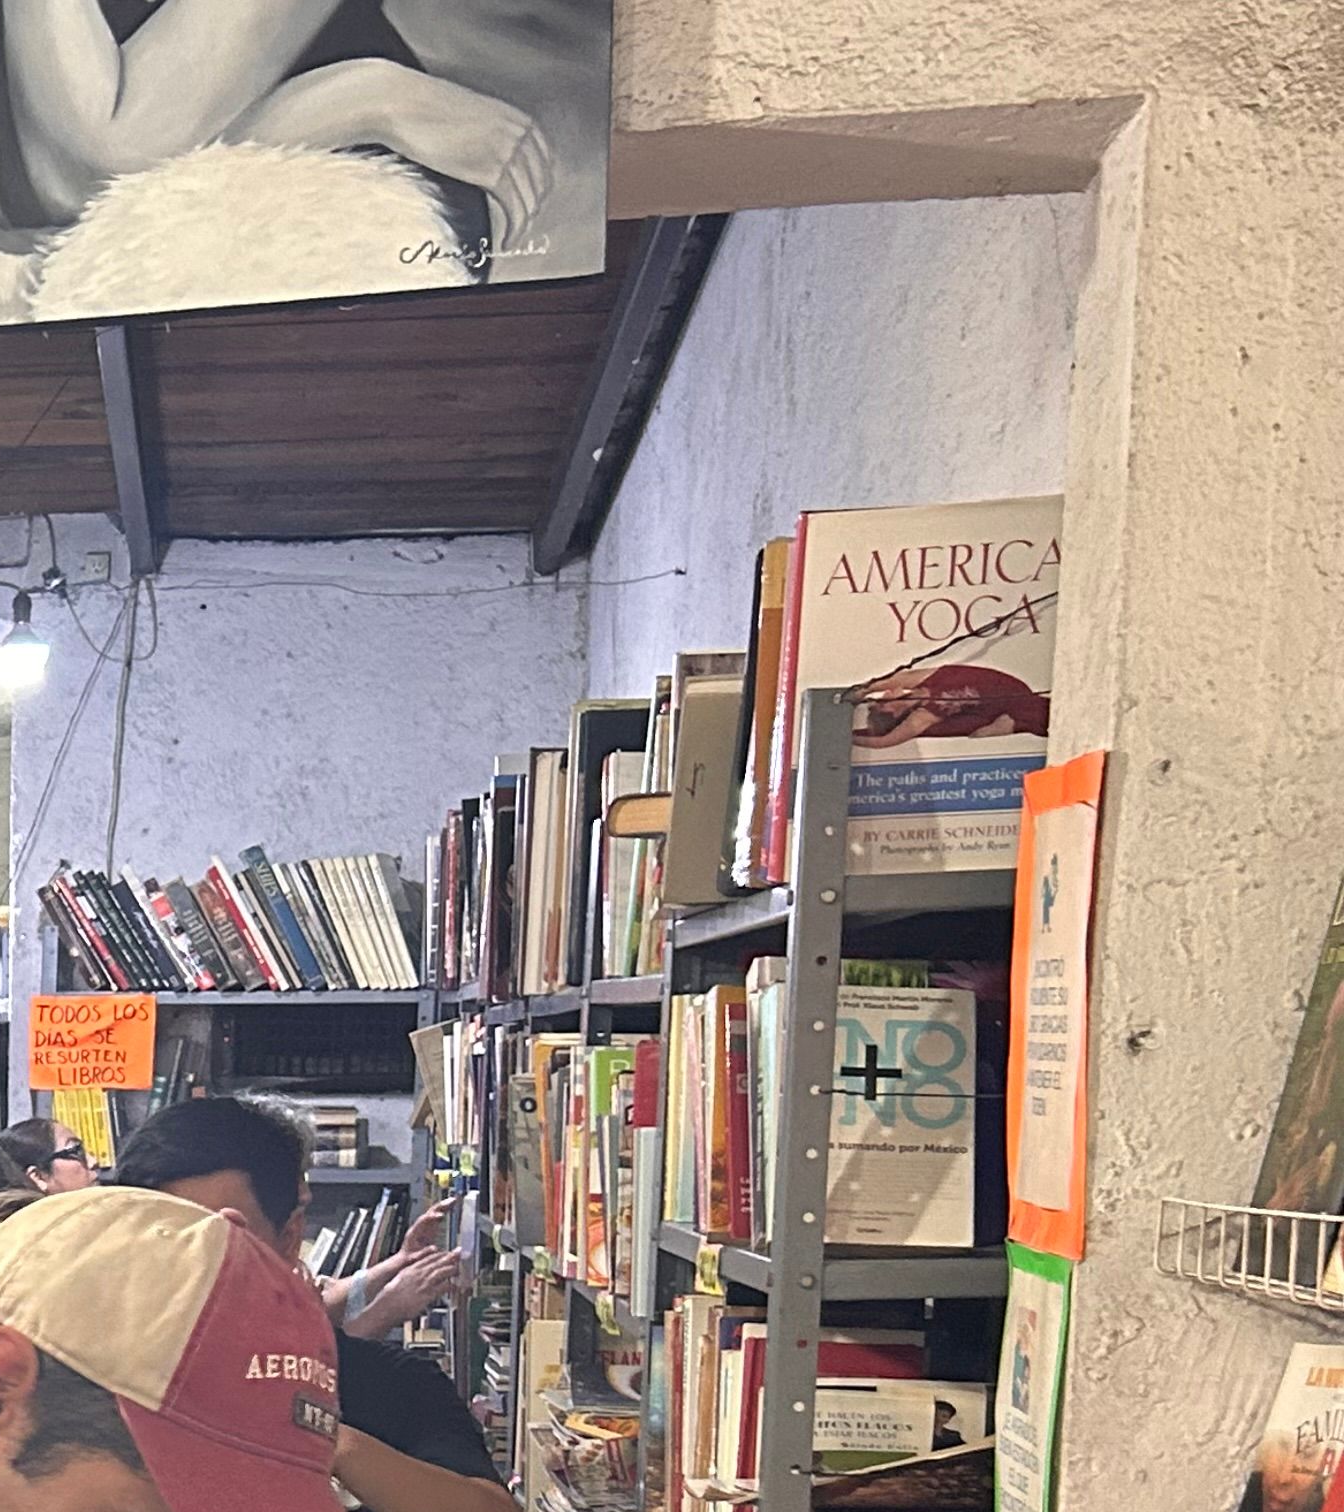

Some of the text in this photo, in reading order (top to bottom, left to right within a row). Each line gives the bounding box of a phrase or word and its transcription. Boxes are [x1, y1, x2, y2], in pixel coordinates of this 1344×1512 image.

[888, 594, 1042, 643] YOGA
[857, 773, 883, 787] The
[888, 771, 926, 788] paths
[930, 769, 957, 783] and
[910, 787, 966, 803] greatest
[972, 787, 1005, 801] yoga
[864, 831, 881, 843] BY
[886, 828, 939, 842] CARRIE
[36, 1003, 149, 1024] TODOS LOS
[95, 1027, 118, 1045] SE
[34, 1049, 127, 1065] RESURTEN
[58, 1066, 126, 1086] LIBROS
[924, 1142, 969, 1155] México
